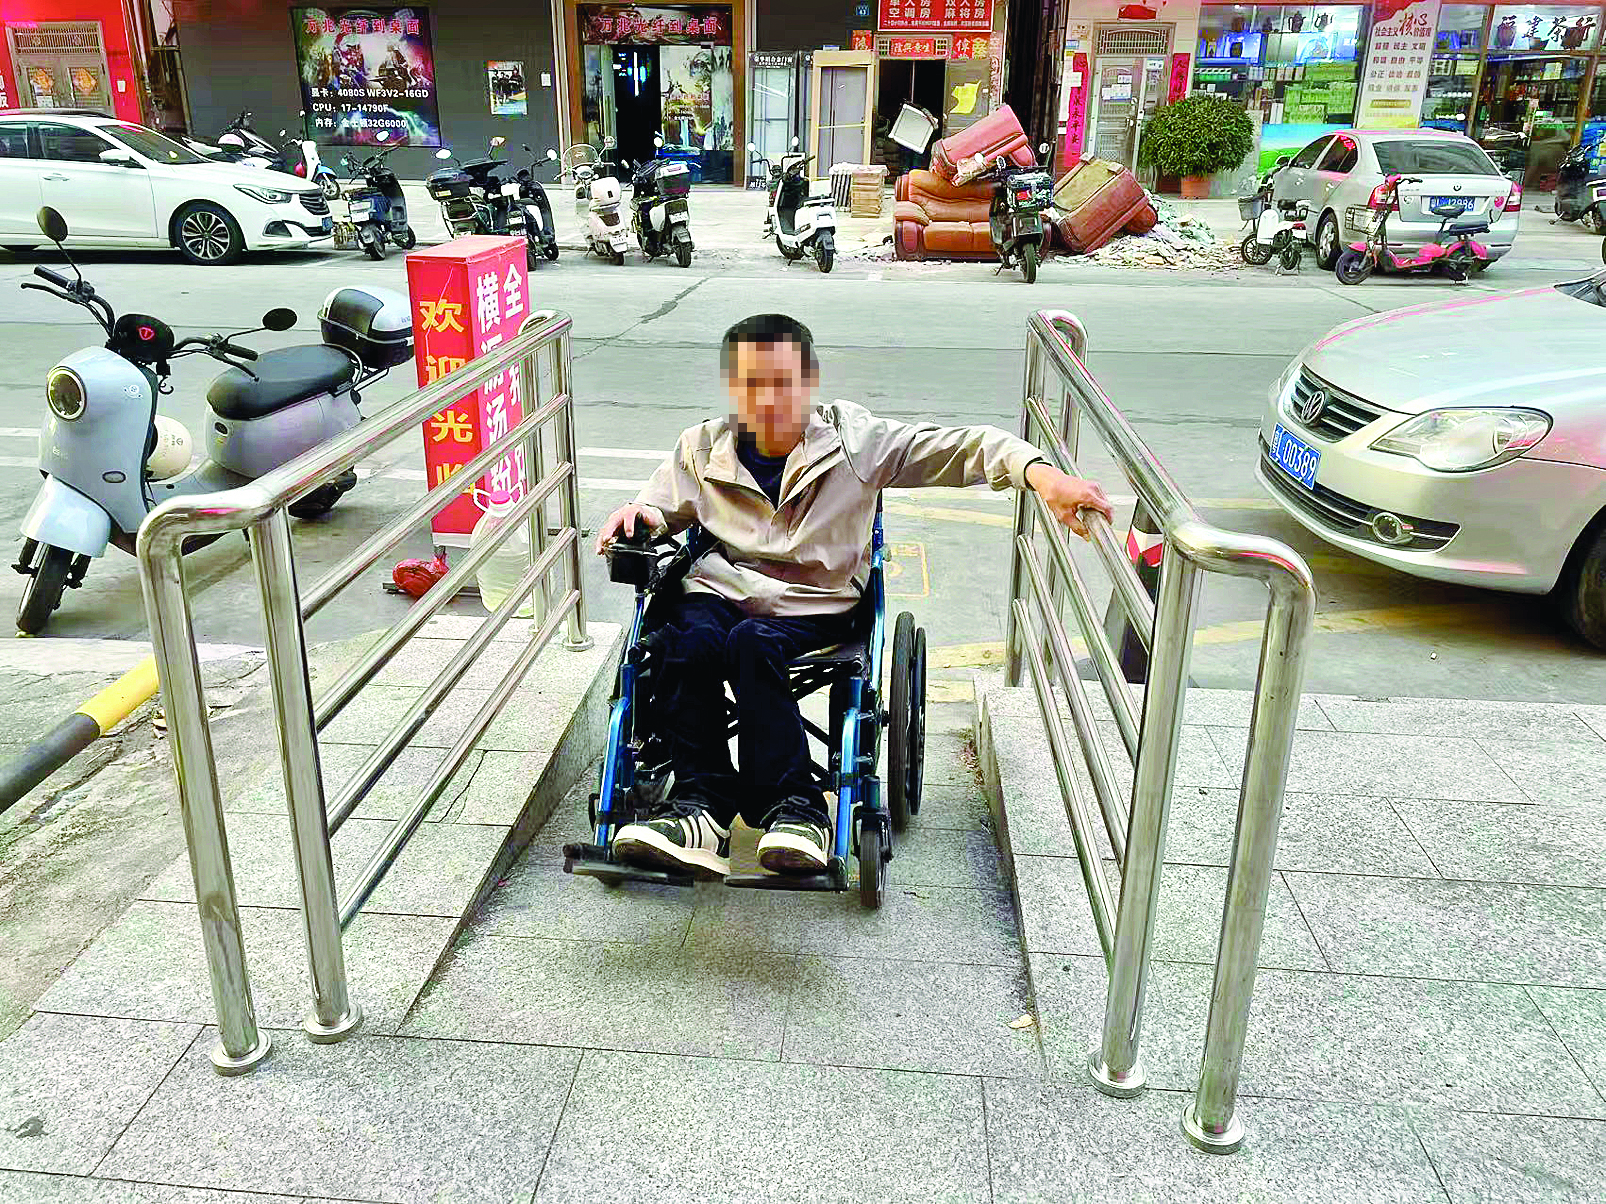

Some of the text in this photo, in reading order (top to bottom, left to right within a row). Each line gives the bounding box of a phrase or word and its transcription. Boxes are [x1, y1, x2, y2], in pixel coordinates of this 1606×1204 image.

[888, 7, 986, 19] 空调房 麻将房
[1374, 26, 1399, 36] 社会主义
